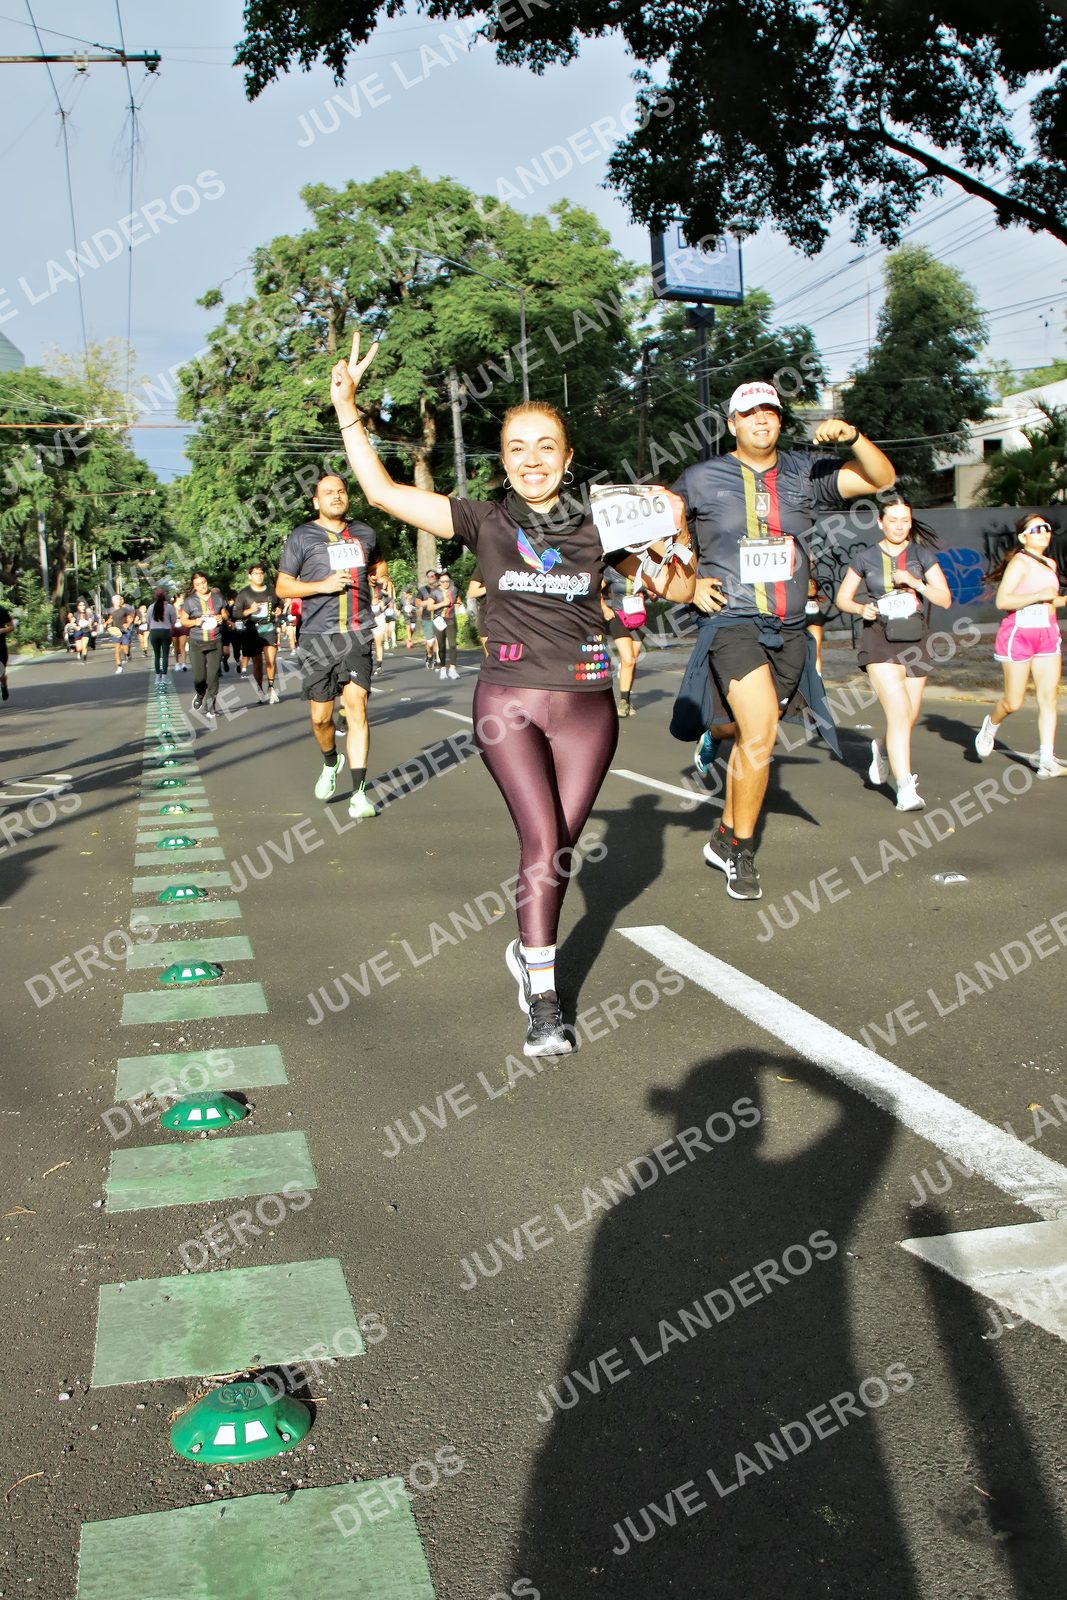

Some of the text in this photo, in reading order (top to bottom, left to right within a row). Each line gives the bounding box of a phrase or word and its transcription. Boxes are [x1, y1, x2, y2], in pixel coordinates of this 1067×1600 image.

[599, 496, 666, 528] 12806
[330, 546, 360, 559] 12518
[744, 552, 787, 567] 10715
[499, 644, 524, 662] LU
